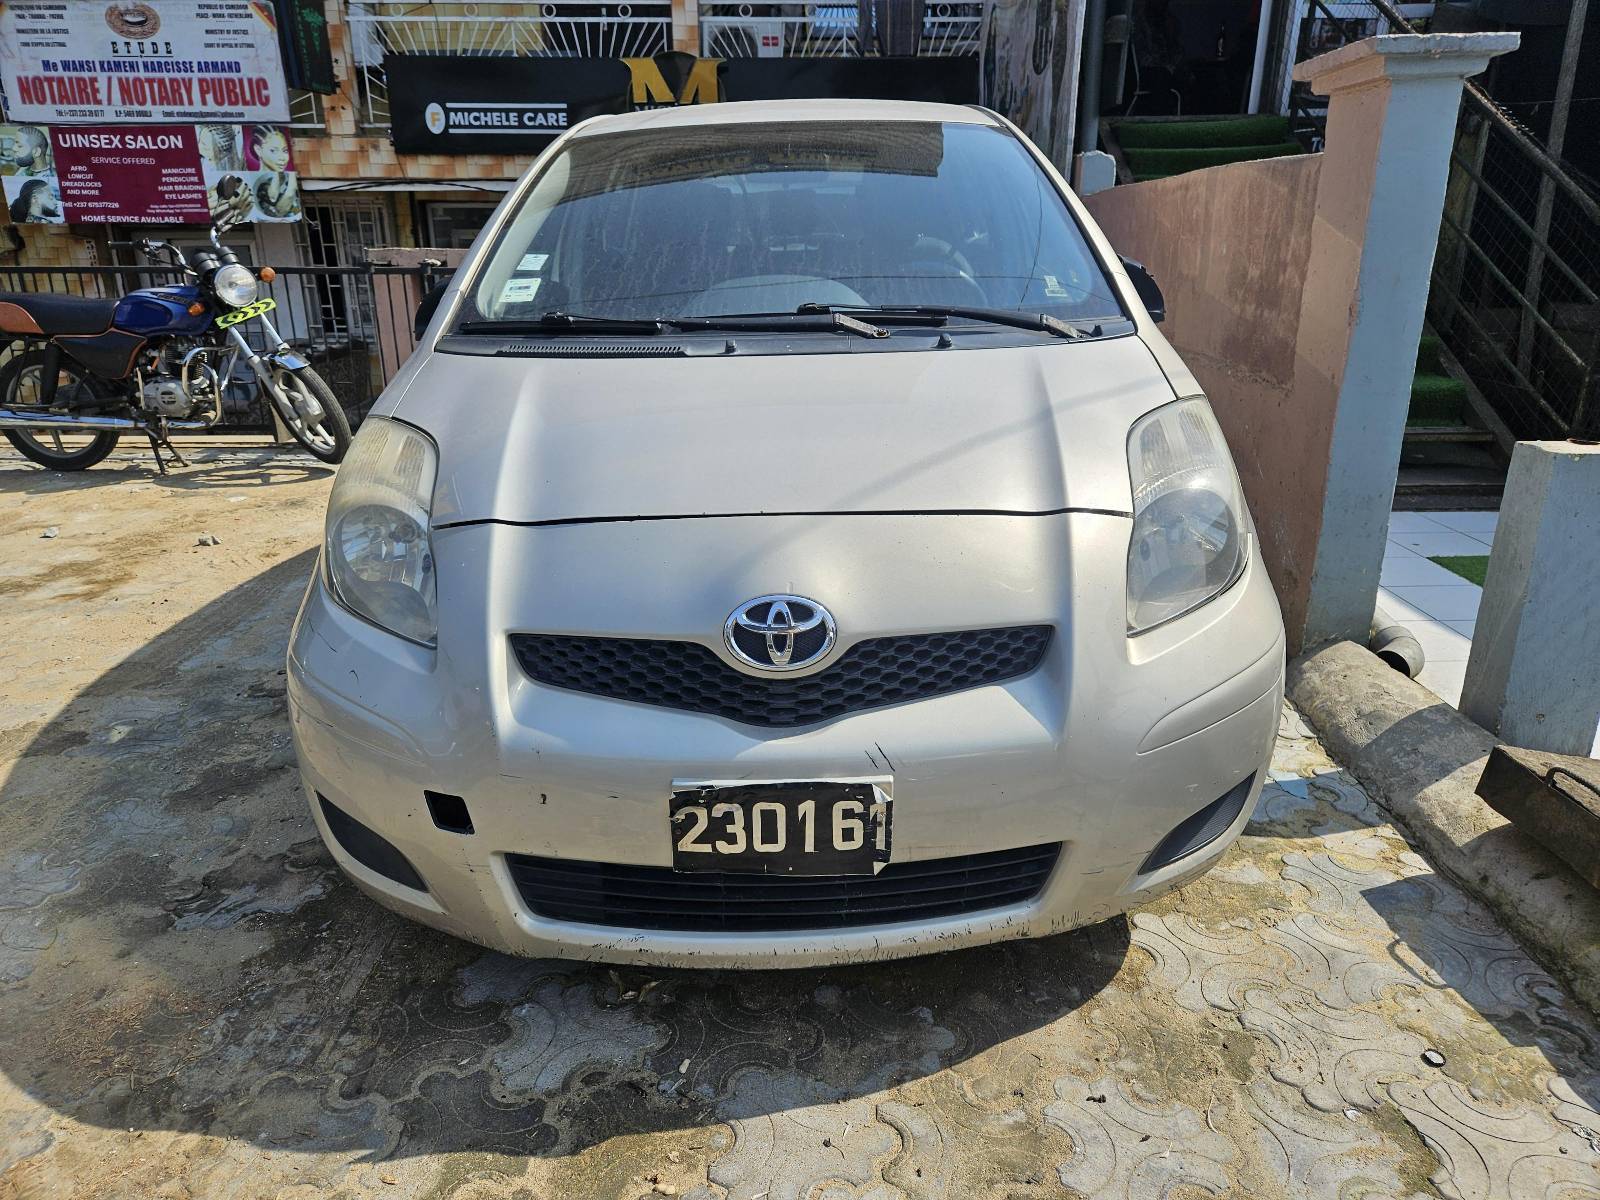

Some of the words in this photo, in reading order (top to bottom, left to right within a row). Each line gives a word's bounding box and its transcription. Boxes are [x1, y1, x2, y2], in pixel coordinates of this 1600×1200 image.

[111, 41, 173, 54] ETUDE
[42, 60, 58, 72] Me
[60, 60, 97, 72] WANSI
[99, 60, 141, 73] KAMENI
[143, 61, 195, 73] NARCISSE
[197, 61, 241, 74] ARMAND
[16, 75, 103, 105] NOTAIRE
[106, 75, 113, 106] /
[116, 75, 194, 106] NOTARY
[197, 76, 271, 107] PUBLIC
[449, 111, 519, 126] MICHELE
[523, 112, 568, 126] CARE
[58, 133, 122, 148] UINSEX
[124, 134, 183, 149] SALON
[91, 156, 121, 164] SERVICE
[122, 157, 156, 165] OFFERED
[106, 215, 139, 223] SERVICE
